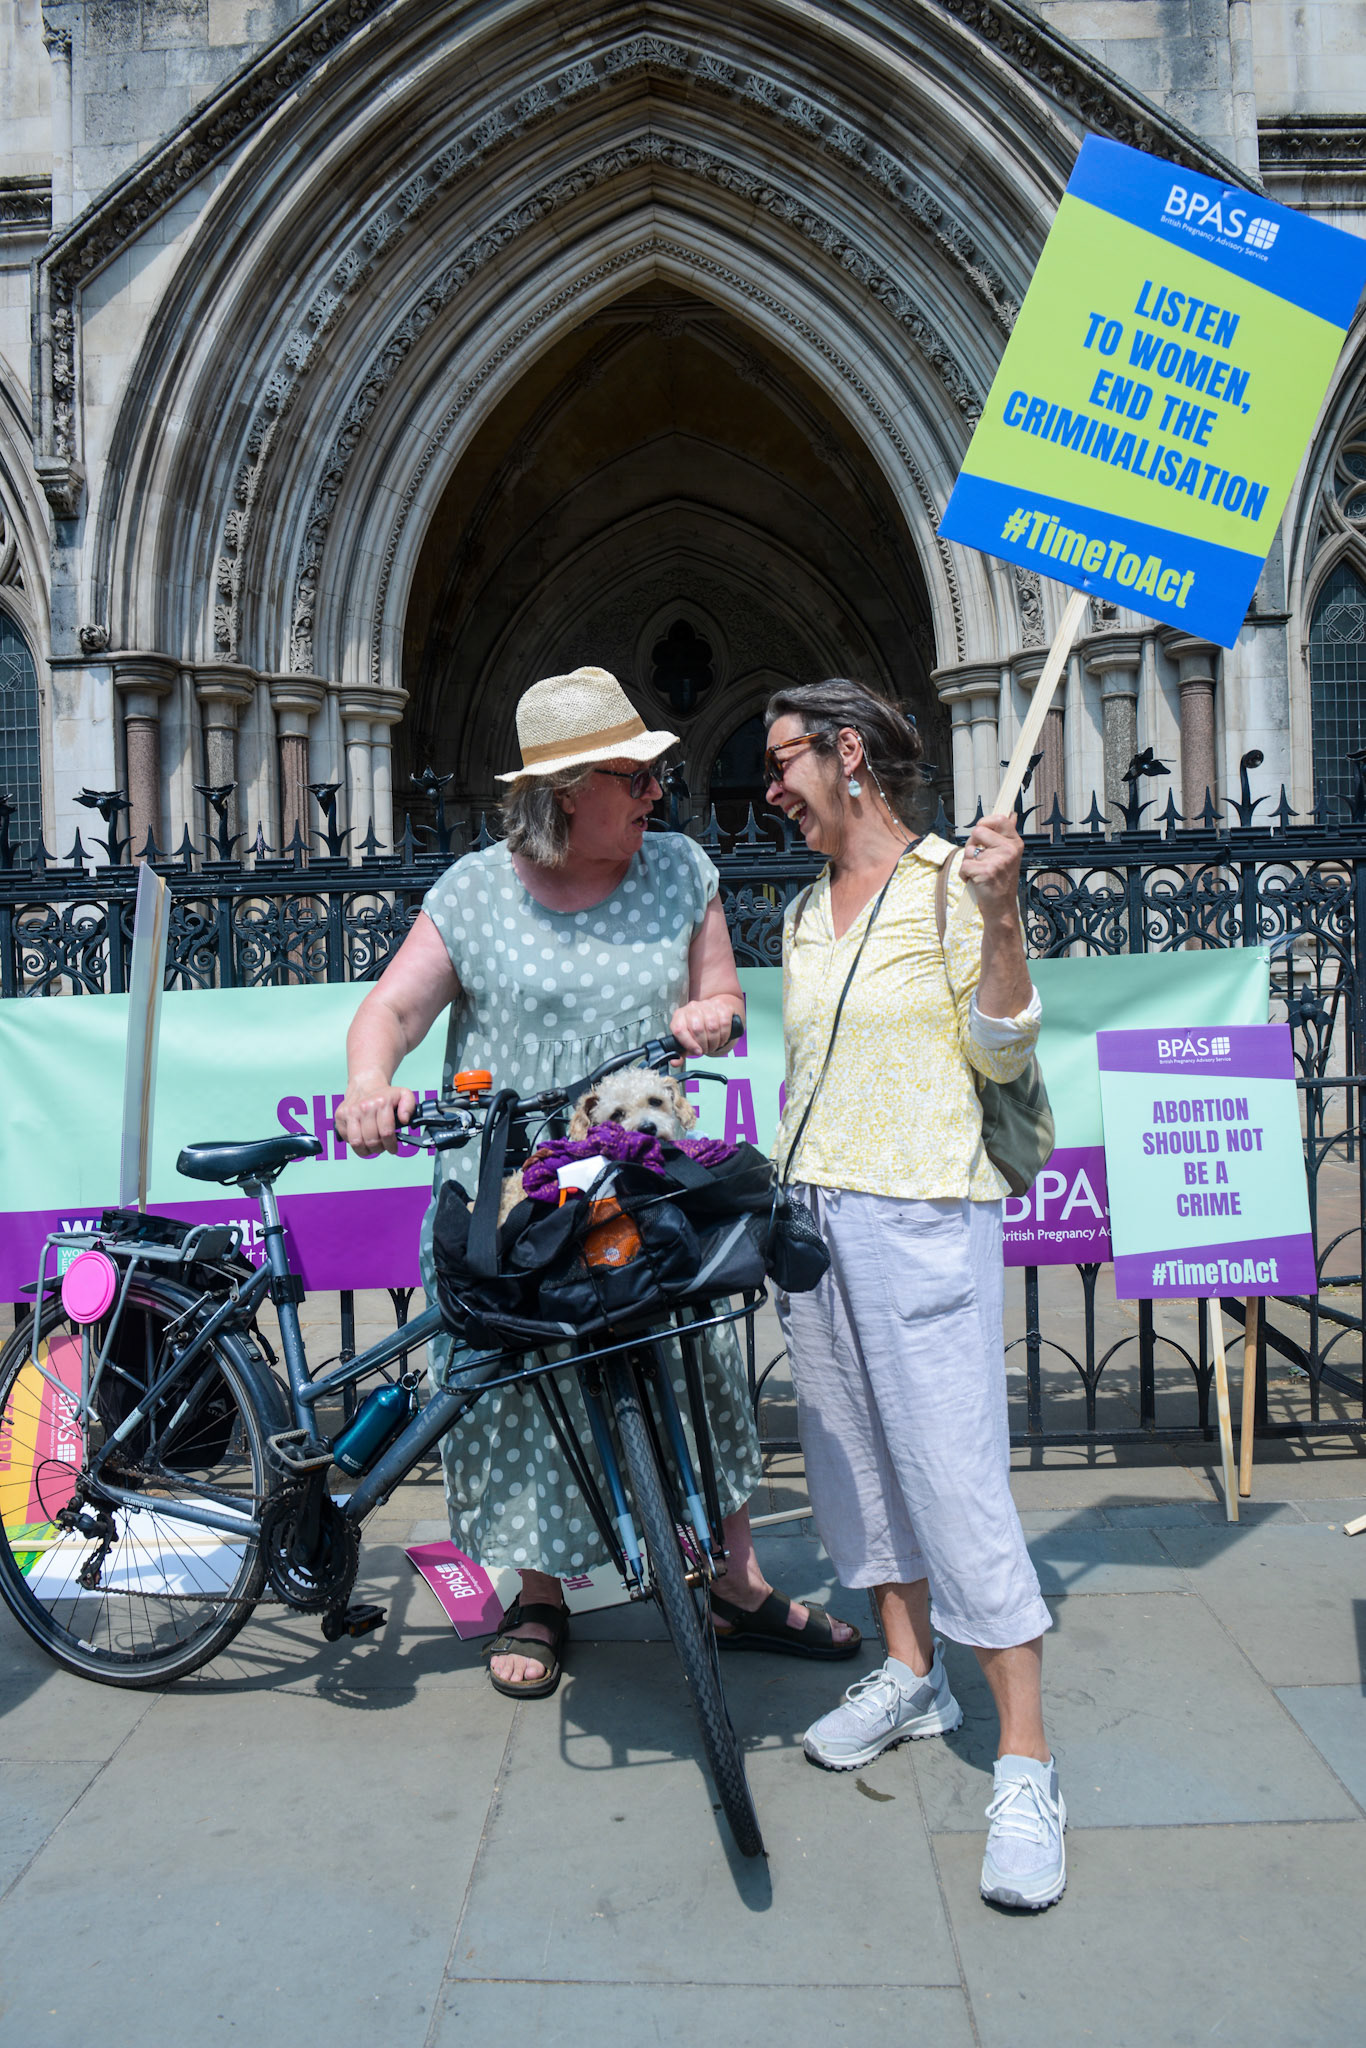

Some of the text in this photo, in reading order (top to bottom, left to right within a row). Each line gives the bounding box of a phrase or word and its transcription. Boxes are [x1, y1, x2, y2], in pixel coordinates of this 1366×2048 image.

[1164, 184, 1247, 238] BPAS
[1160, 215, 1269, 262] British Pregnancy Advisory Service
[1134, 280, 1240, 349] LISTEN
[1082, 313, 1251, 414] TO WOMEN,
[1088, 370, 1218, 449] END THE
[1002, 391, 1270, 523] CRIMINALISATION
[1000, 507, 1195, 609] #TimeToAct
[1158, 1037, 1210, 1058] BPAS
[724, 1078, 759, 1145] A
[1152, 1098, 1249, 1124] ABORTION
[1142, 1128, 1264, 1155] SHOULD NOT
[1002, 1168, 1110, 1223] BPA
[1184, 1160, 1229, 1185] BE A
[1176, 1192, 1242, 1217] CRIME
[1037, 1228, 1096, 1243] Pregnancy
[1151, 1258, 1279, 1286] #TimeToAct
[441, 1571, 477, 1599] BPAS
